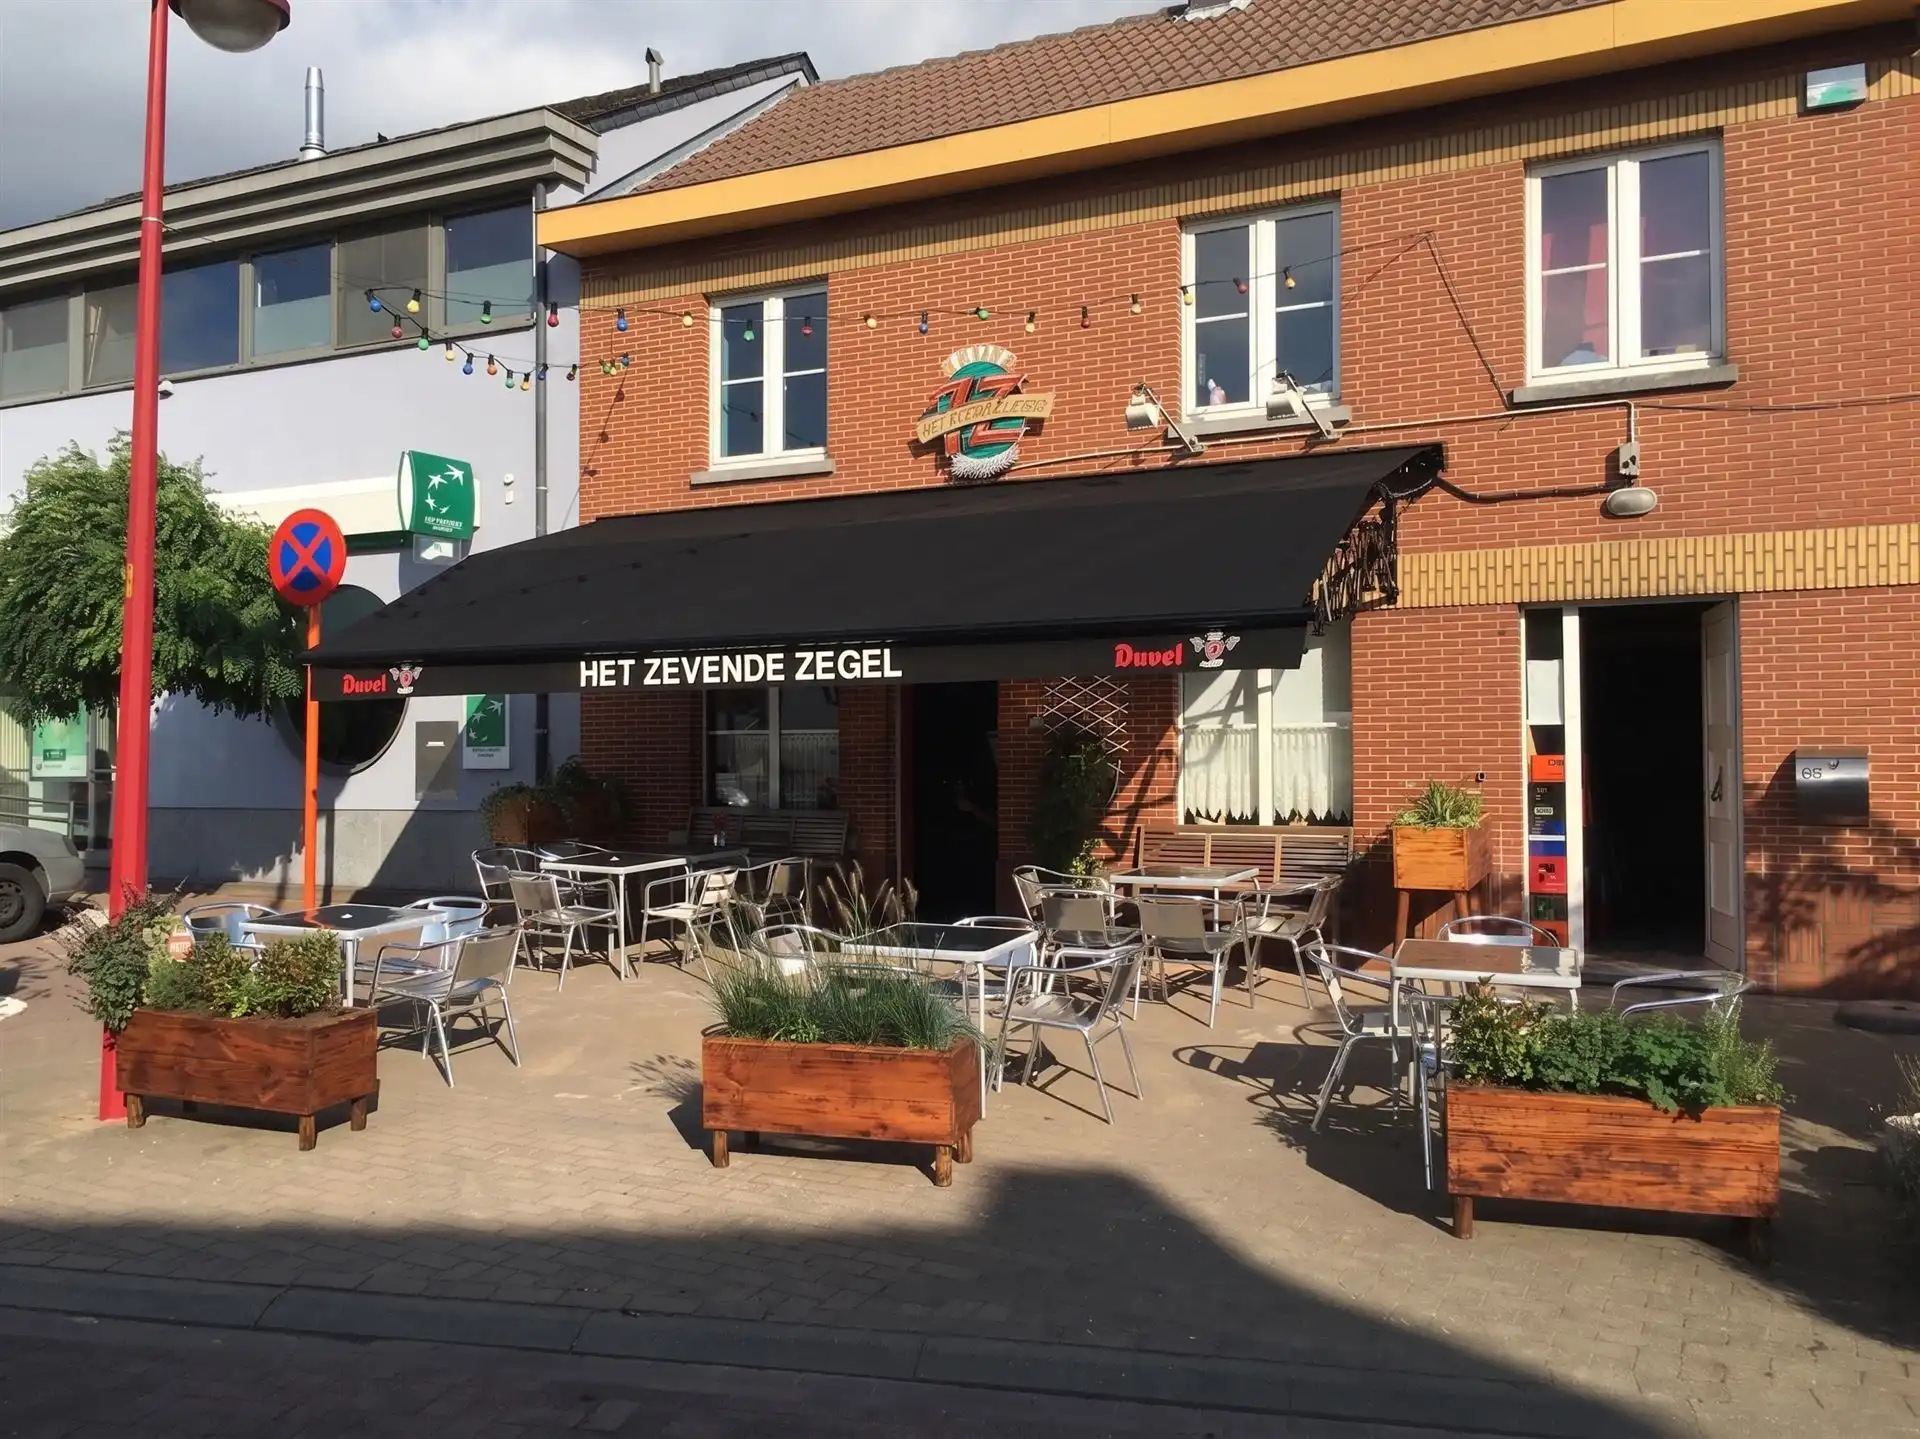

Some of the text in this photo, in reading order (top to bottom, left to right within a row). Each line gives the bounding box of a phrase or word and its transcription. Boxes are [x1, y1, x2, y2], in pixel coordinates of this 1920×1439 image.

[580, 648, 902, 687] HET ZEVENDE ZEGEL
[1114, 642, 1183, 668] Duvel
[343, 674, 387, 694] Duvel
